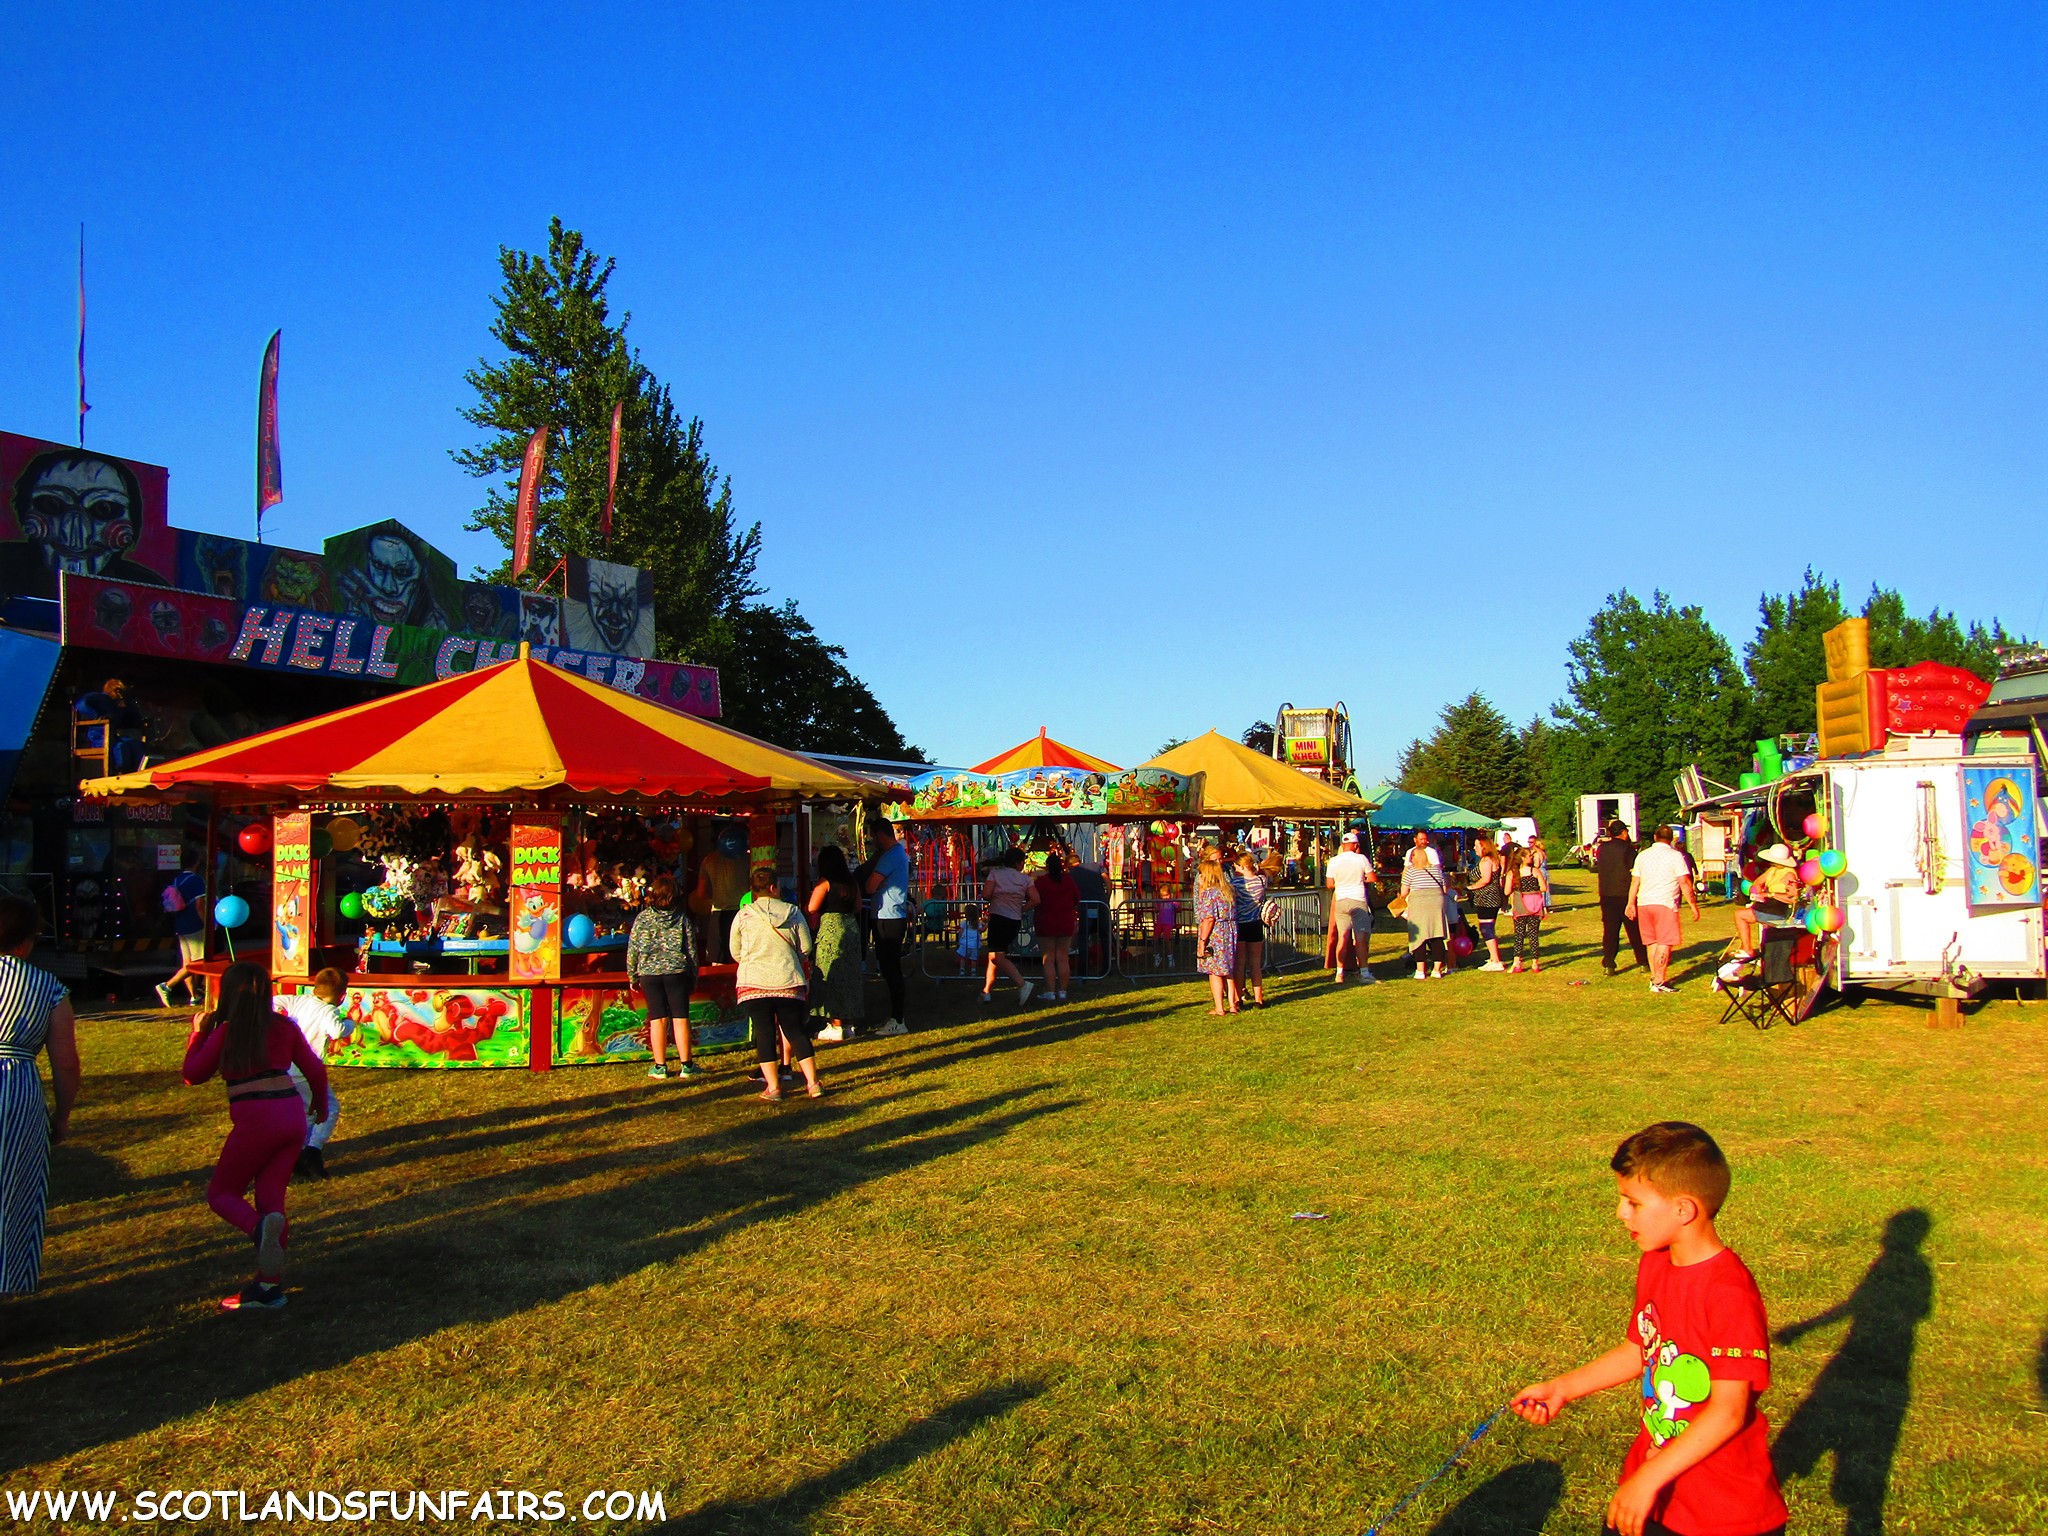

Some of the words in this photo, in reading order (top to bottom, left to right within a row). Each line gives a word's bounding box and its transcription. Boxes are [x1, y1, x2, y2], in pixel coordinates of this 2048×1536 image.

[228, 605, 399, 679] HELL
[434, 635, 646, 696] CHER
[1295, 741, 1317, 750] MINI
[1292, 751, 1323, 760] WHEEL
[276, 844, 310, 862] DUCK
[514, 846, 560, 865] DUCK
[275, 863, 310, 883] GAME
[511, 866, 560, 886] GAME
[1711, 1346, 1742, 1358] SUPER
